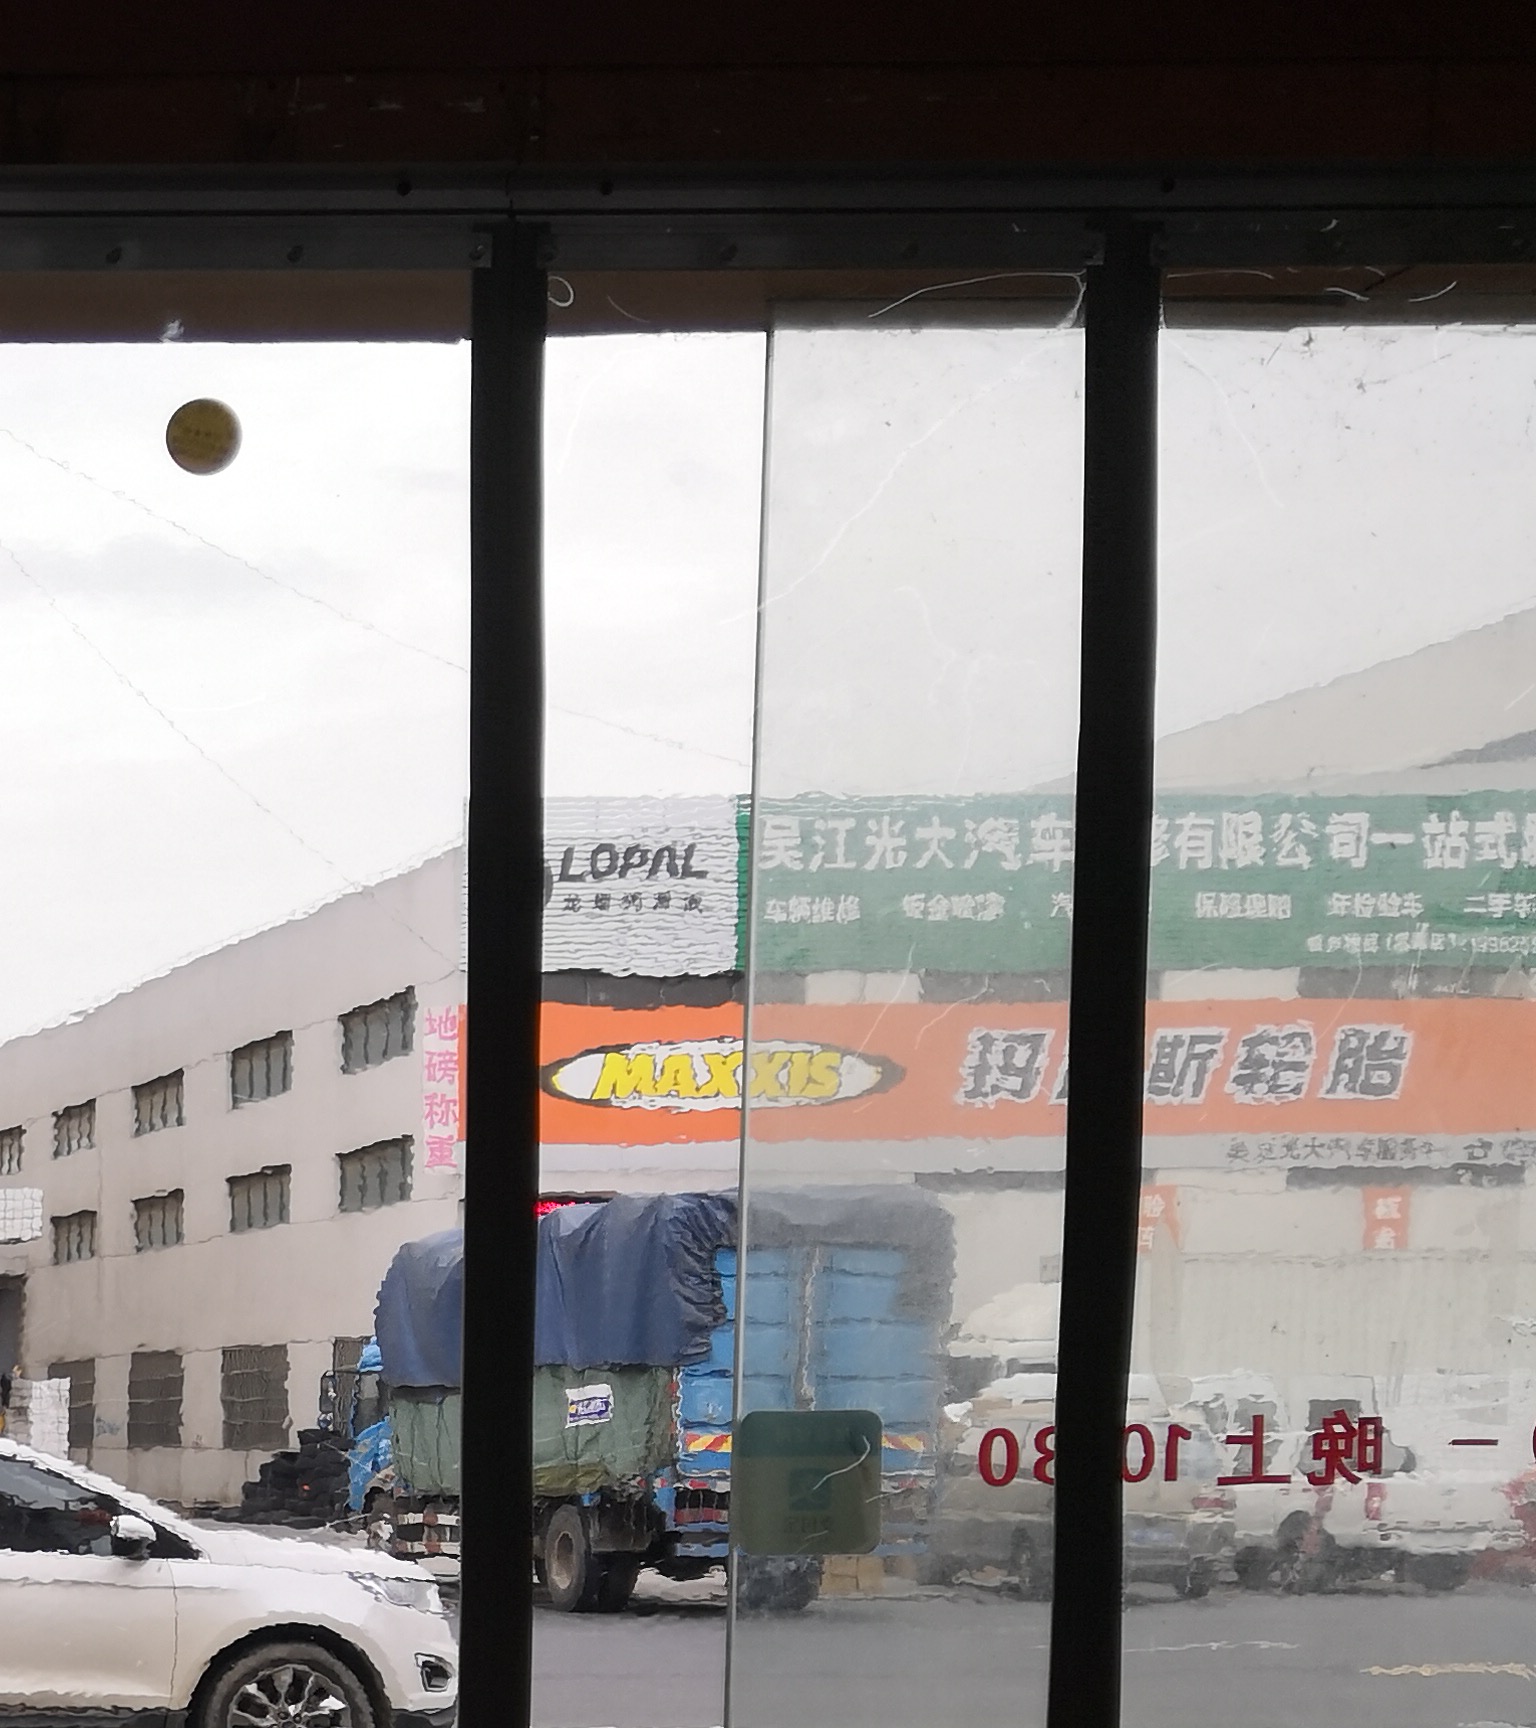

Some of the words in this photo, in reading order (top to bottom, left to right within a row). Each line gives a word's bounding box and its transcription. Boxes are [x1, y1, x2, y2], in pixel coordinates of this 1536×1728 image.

[559, 843, 709, 882] LOPAL
[759, 808, 1536, 872] 吴江光大汽车有限公司一站式
[425, 1007, 460, 1168] 地磅称重
[592, 1049, 841, 1100] MAXXIS
[960, 1026, 1412, 1104] 玛斯轮胎
